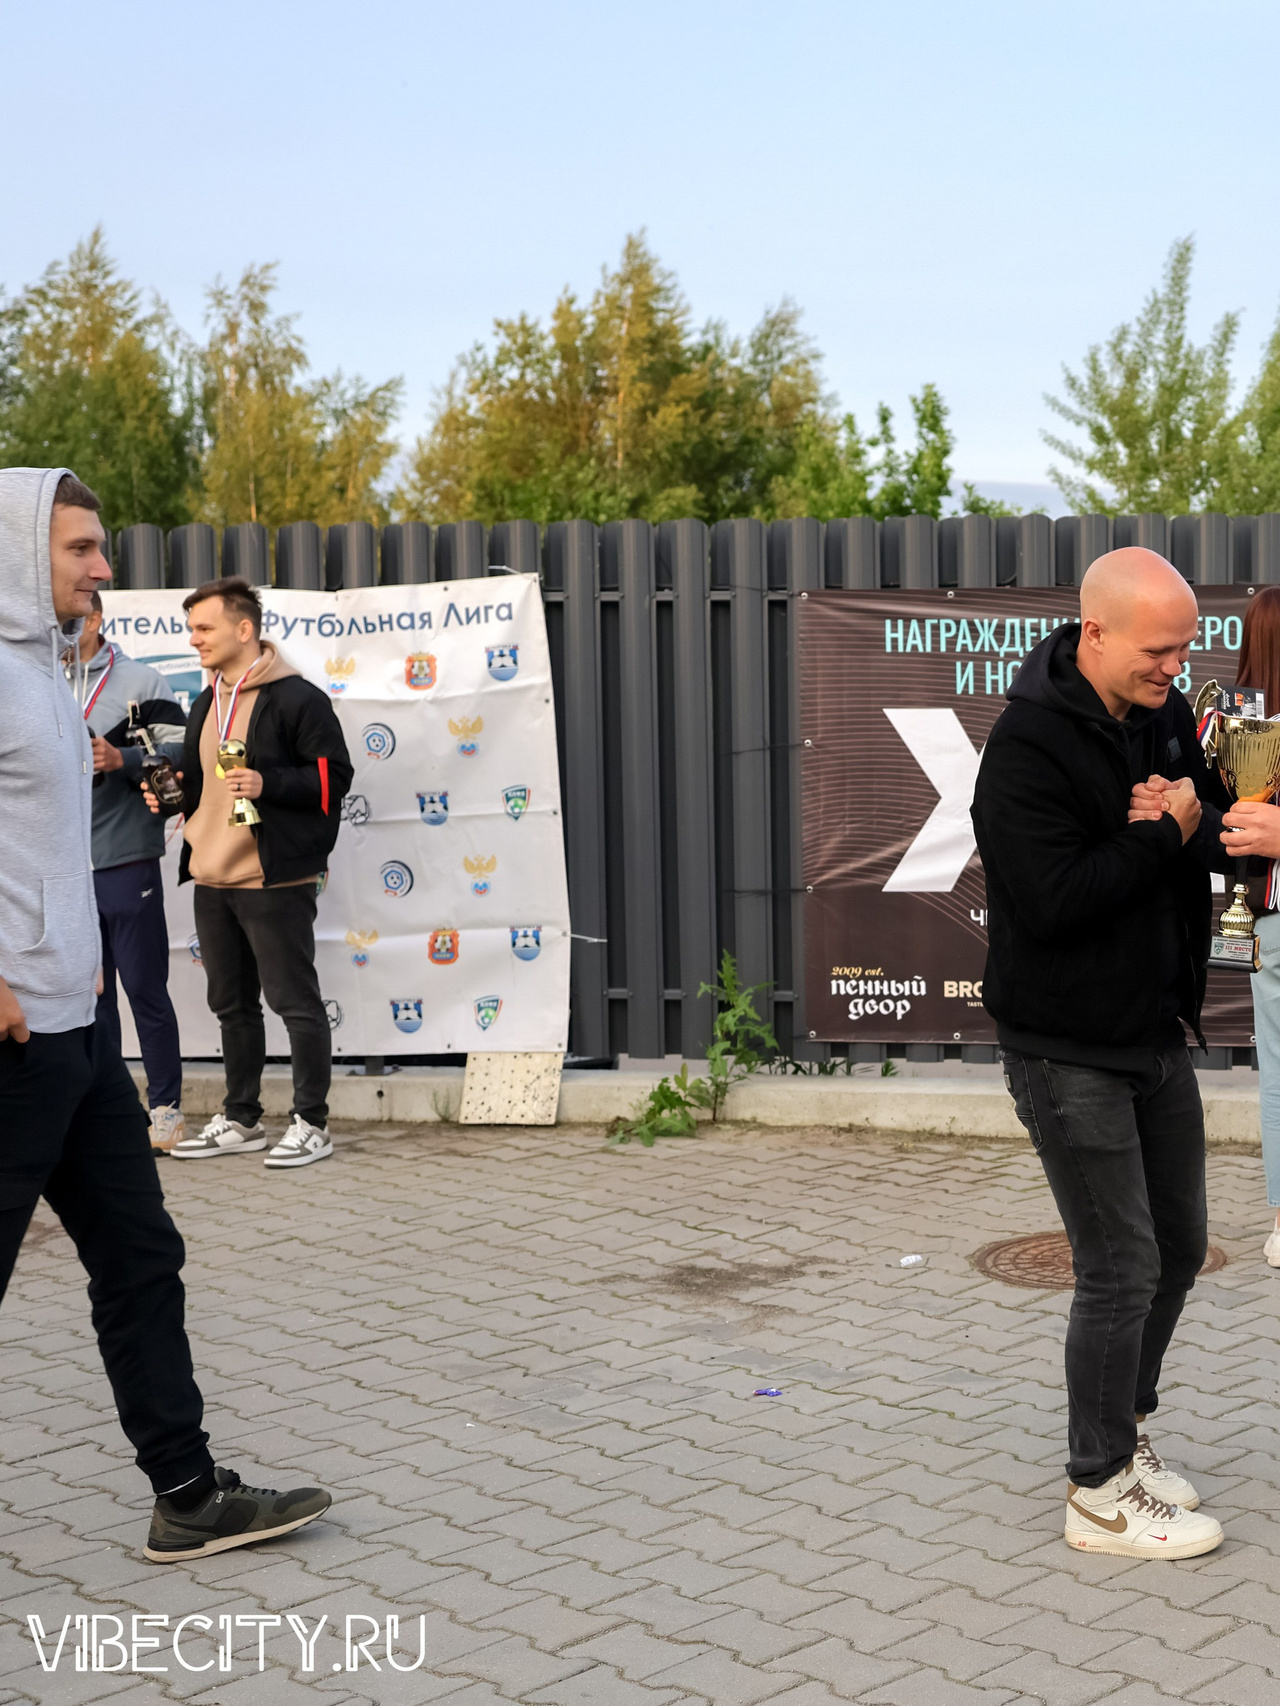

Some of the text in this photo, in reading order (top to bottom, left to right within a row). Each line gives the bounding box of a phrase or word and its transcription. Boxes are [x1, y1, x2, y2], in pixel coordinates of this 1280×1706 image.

[443, 602, 513, 628] Лига
[955, 661, 974, 694] И
[831, 966, 862, 978] 2009
